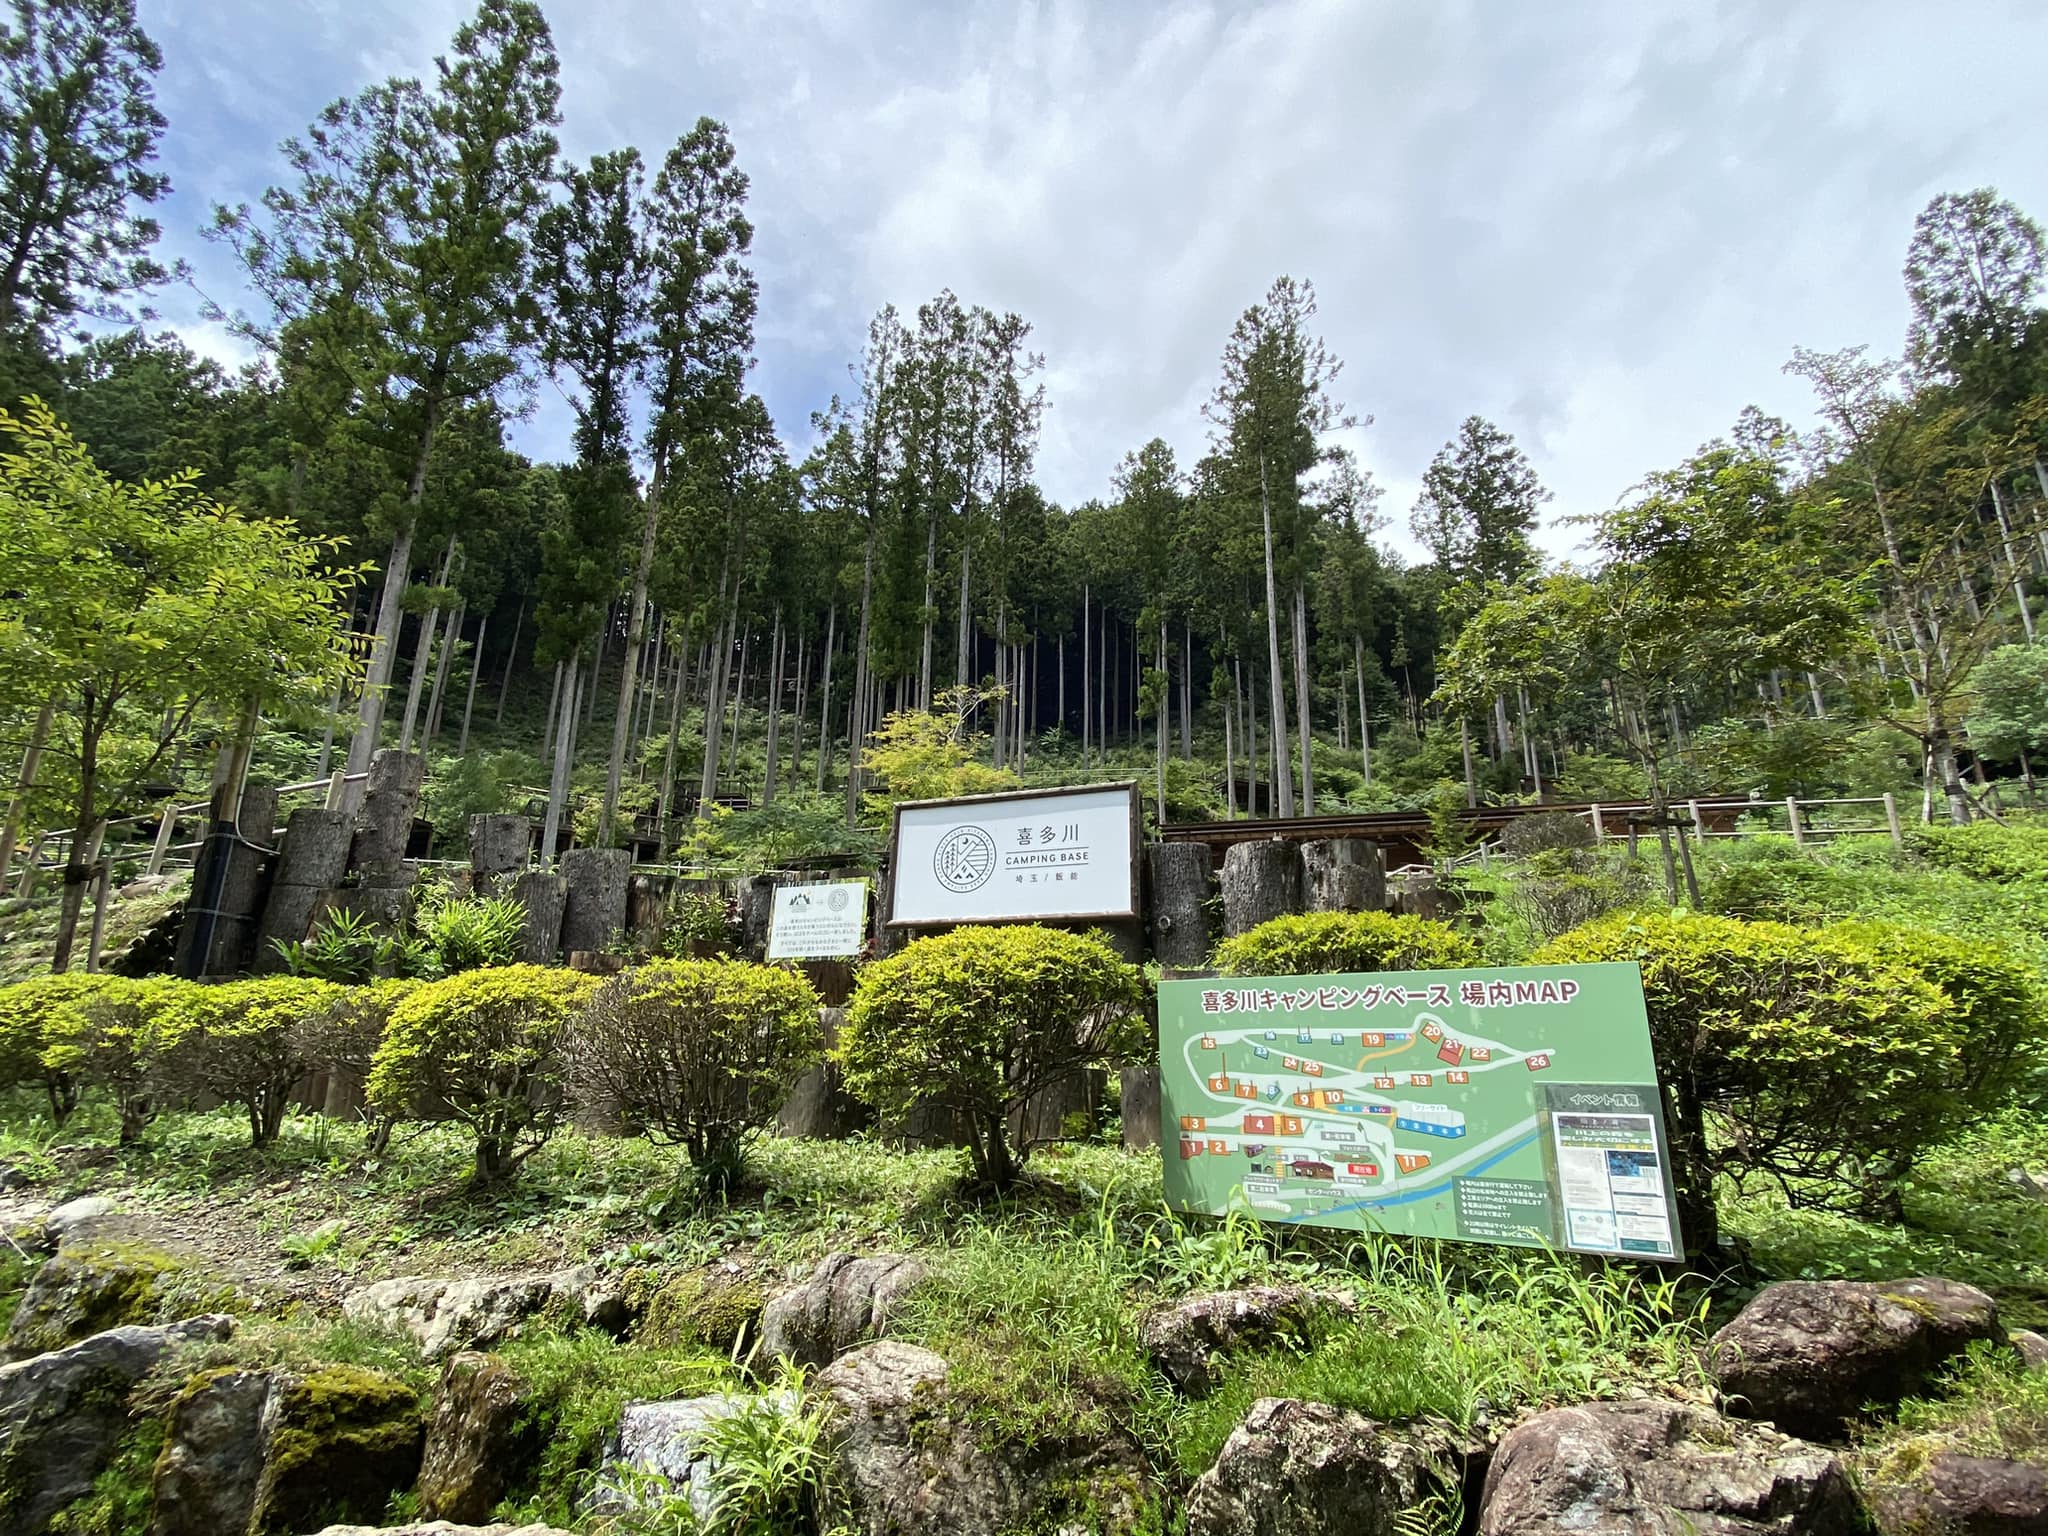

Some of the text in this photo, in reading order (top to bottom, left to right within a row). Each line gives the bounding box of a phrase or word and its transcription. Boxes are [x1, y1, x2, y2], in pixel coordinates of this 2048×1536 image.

[1017, 824, 1079, 846] 喜多川
[1005, 851, 1089, 866] CAMPING BASE
[1202, 981, 1578, 1012] 喜多川キャンピングベース 場内MAP
[1425, 1026, 1441, 1037] 20
[1203, 1040, 1214, 1048] 15
[1367, 1034, 1380, 1045] 19
[1445, 1040, 1458, 1049] 21
[1472, 1048, 1487, 1057] 22
[1284, 1058, 1296, 1067] 24
[1305, 1062, 1319, 1071] 25
[1530, 1057, 1546, 1067] 26
[1414, 1075, 1428, 1085] 13
[1450, 1073, 1465, 1082] 14
[1216, 1081, 1223, 1090] 6
[1377, 1079, 1390, 1089] 12
[1243, 1087, 1250, 1096] 7
[1269, 1086, 1275, 1095] 8
[1301, 1095, 1309, 1105] 9
[1327, 1092, 1340, 1102] 10
[1570, 1094, 1641, 1107] イベント情報
[1192, 1118, 1199, 1129] 3
[1256, 1119, 1264, 1130] 4
[1289, 1121, 1296, 1131] 5
[1191, 1143, 1196, 1152] 1
[1215, 1142, 1222, 1152] 2
[1403, 1156, 1416, 1167] 11
